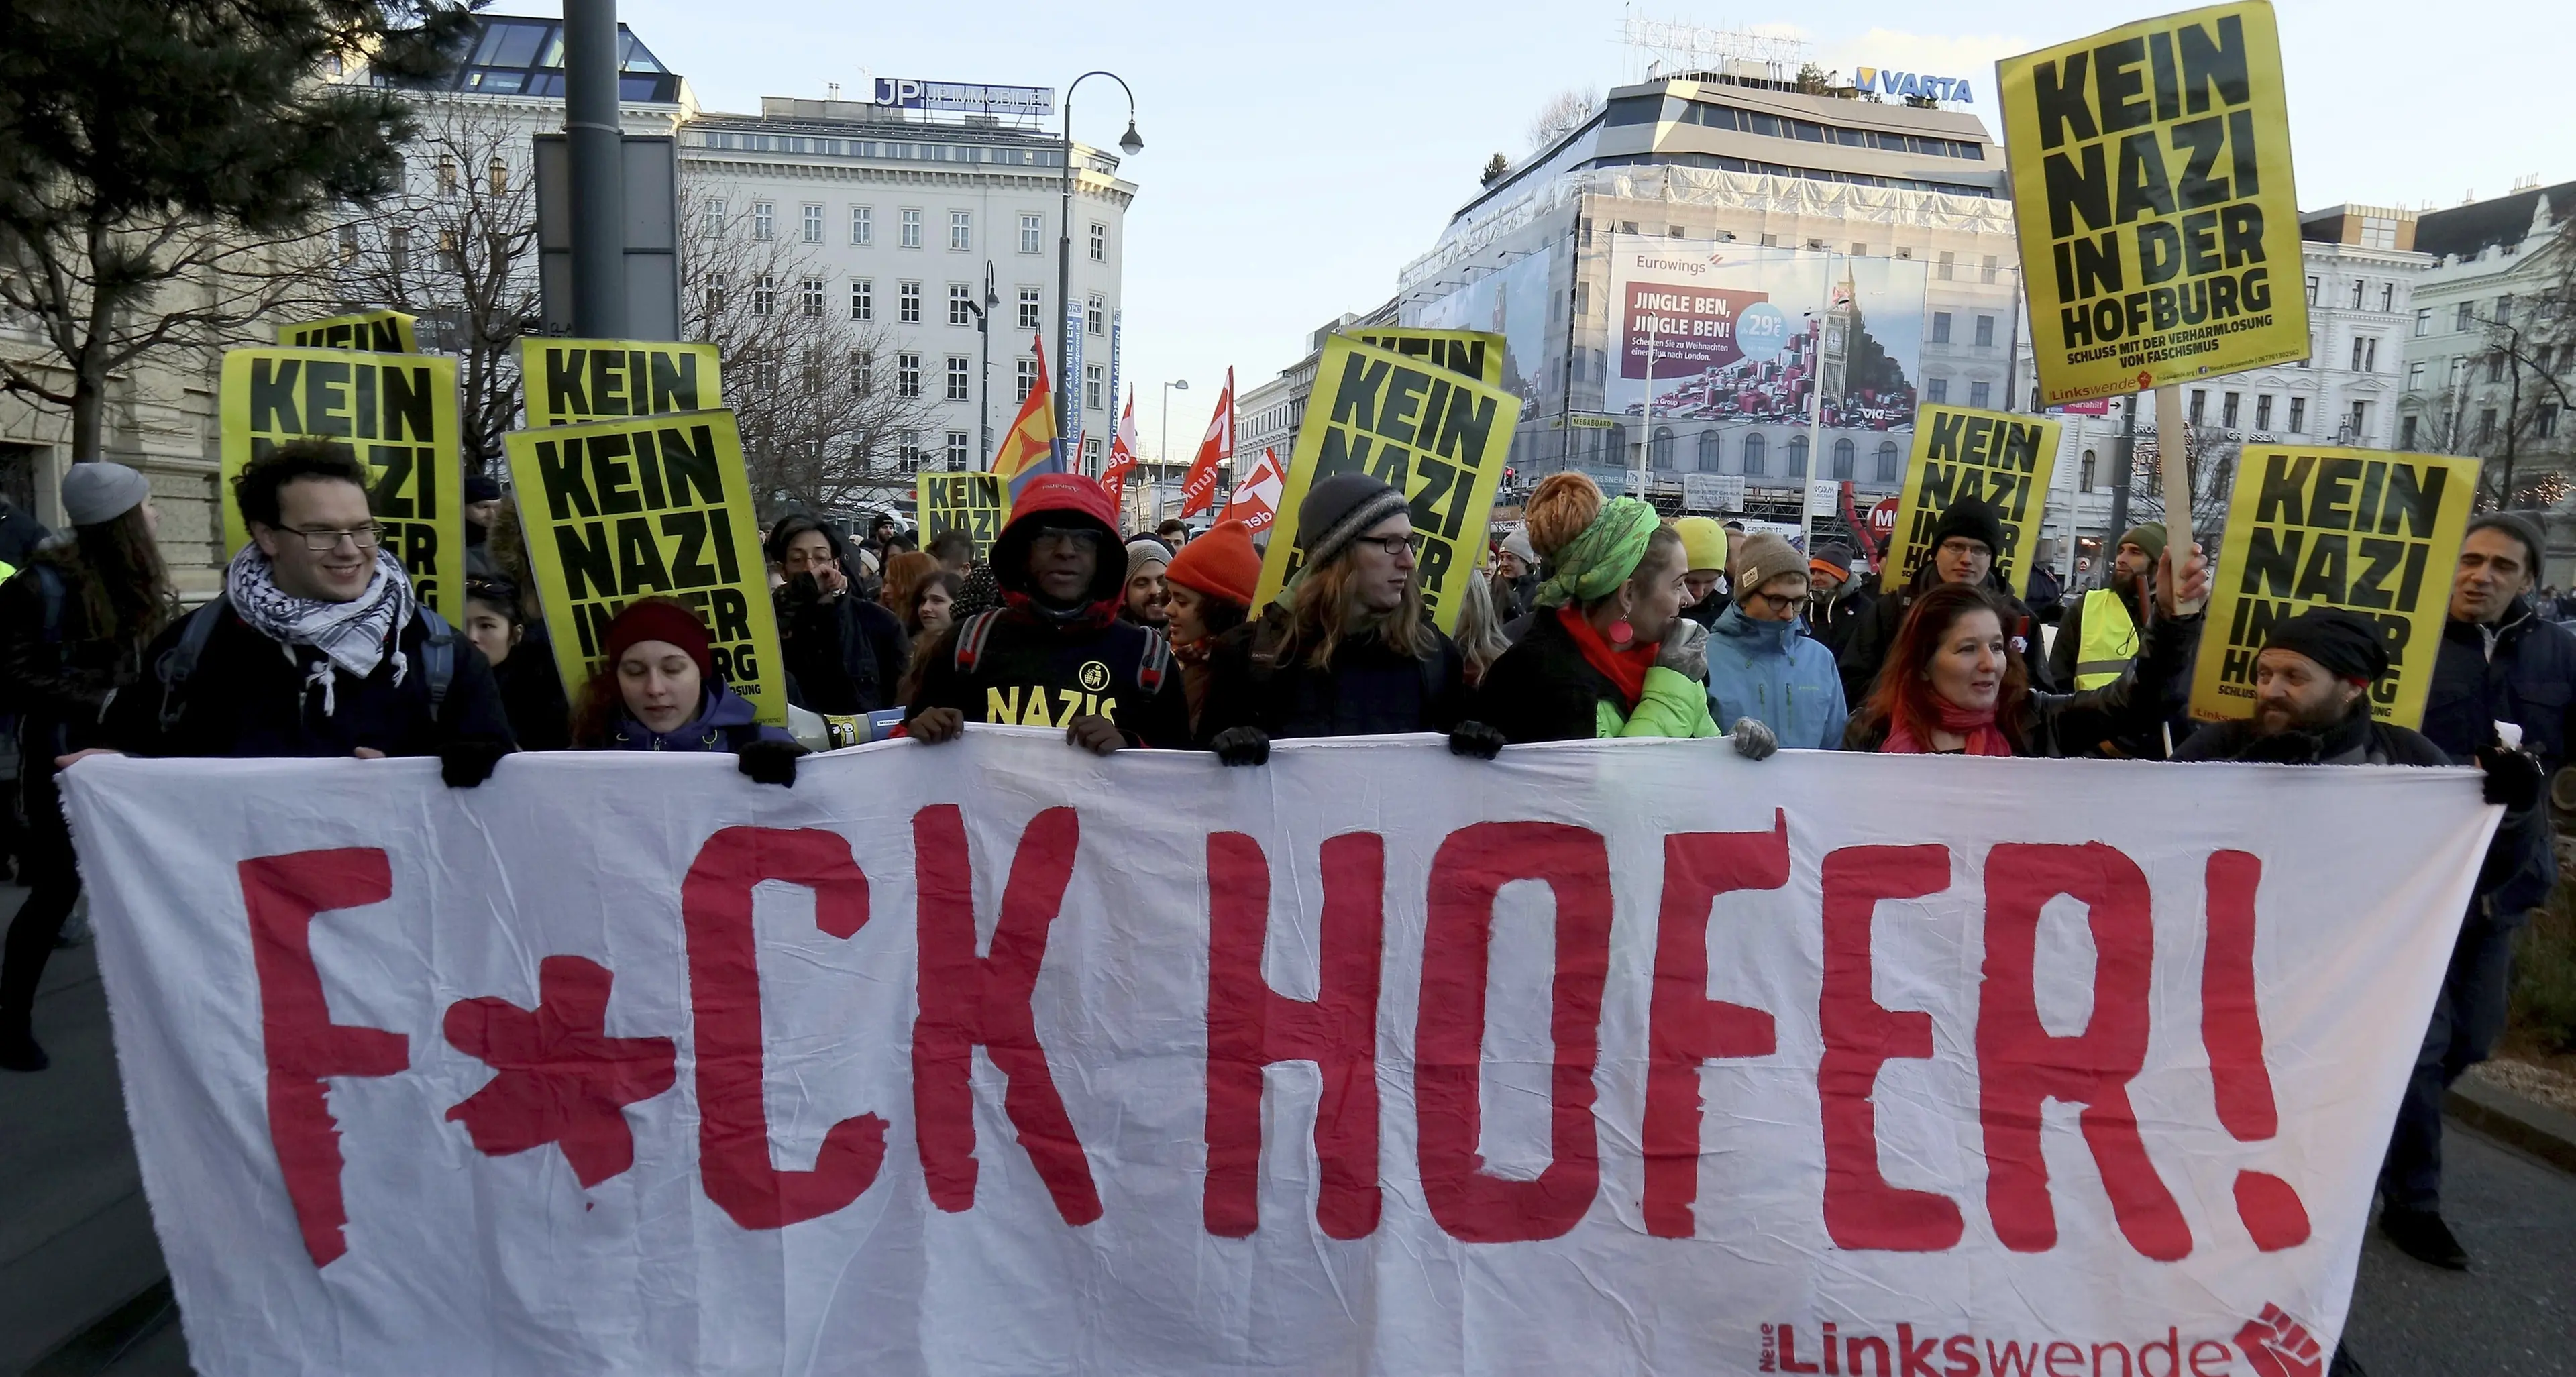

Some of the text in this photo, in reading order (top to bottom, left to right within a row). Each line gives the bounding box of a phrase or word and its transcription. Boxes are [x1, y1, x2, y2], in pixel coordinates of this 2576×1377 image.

[876, 79, 920, 105] JP
[926, 85, 1053, 109] JP IMMOBILIEN
[1881, 70, 1974, 103] VARTA
[2033, 15, 2250, 150] KEIN
[2043, 109, 2259, 239] NAZI
[1637, 255, 1705, 276] Eurowings
[2053, 203, 2265, 304] IN DER
[1634, 292, 1731, 318] JINGLE BEN,
[1693, 320, 1730, 338] BEN!
[1748, 314, 1773, 336] 29
[2061, 268, 2271, 349] HOFBURG
[1362, 336, 1485, 381] IN
[1665, 339, 1675, 349] Sie
[1686, 341, 1728, 352] Weihnachten
[1667, 351, 1683, 359] nach
[1684, 353, 1711, 361] London.
[2067, 315, 2273, 365] SCHLUSS MIT DER VERHARMLOSUNG
[2120, 339, 2220, 368] VON FASCHISMUS
[250, 357, 434, 443] KEIN
[546, 349, 698, 415] KEIN
[2051, 377, 2137, 402] Linkswende
[1330, 351, 1498, 469] KEIN
[1573, 419, 1611, 427] MEGABOARD
[1927, 412, 2044, 473] KEIN
[2227, 431, 2277, 443] GRSSEN
[250, 437, 437, 520] ZI
[535, 425, 726, 520] KEIN
[928, 476, 1000, 508] KEIN
[1917, 461, 2032, 522] NAZI
[2255, 455, 2449, 539] KEIN
[930, 510, 1001, 541] NAZI
[1876, 509, 1897, 527] M
[381, 522, 437, 576] ER
[553, 508, 741, 601] NAZI
[2240, 527, 2430, 612] NAZI
[2229, 598, 2292, 649] IN
[1203, 807, 2311, 1262] HOFER!
[1760, 1321, 2232, 1377] Neue Linkswende
